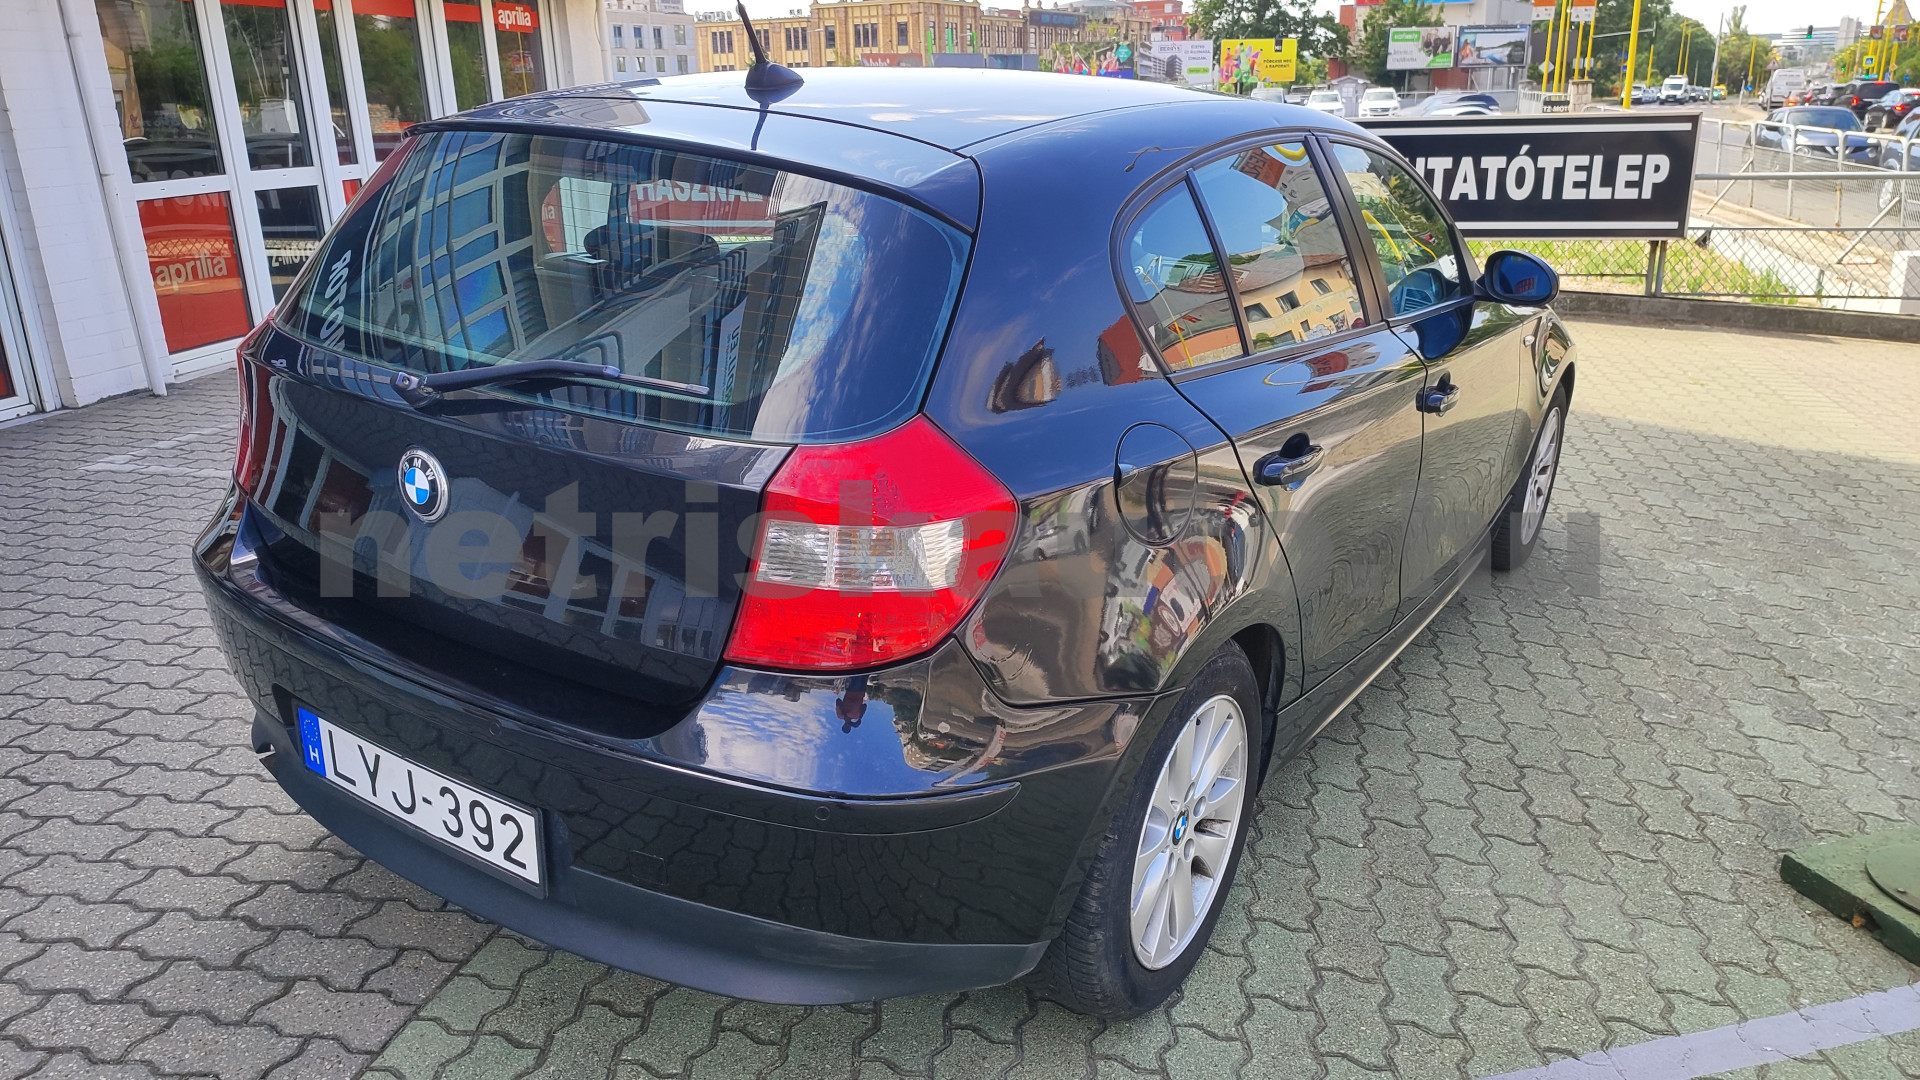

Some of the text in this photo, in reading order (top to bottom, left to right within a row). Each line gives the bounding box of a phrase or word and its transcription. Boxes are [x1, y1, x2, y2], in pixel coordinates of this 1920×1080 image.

[497, 6, 532, 30] aprilia
[635, 179, 764, 202] HASZN
[154, 250, 228, 291] aprilia
[308, 744, 320, 765] H
[328, 729, 527, 870] LYJ-392
